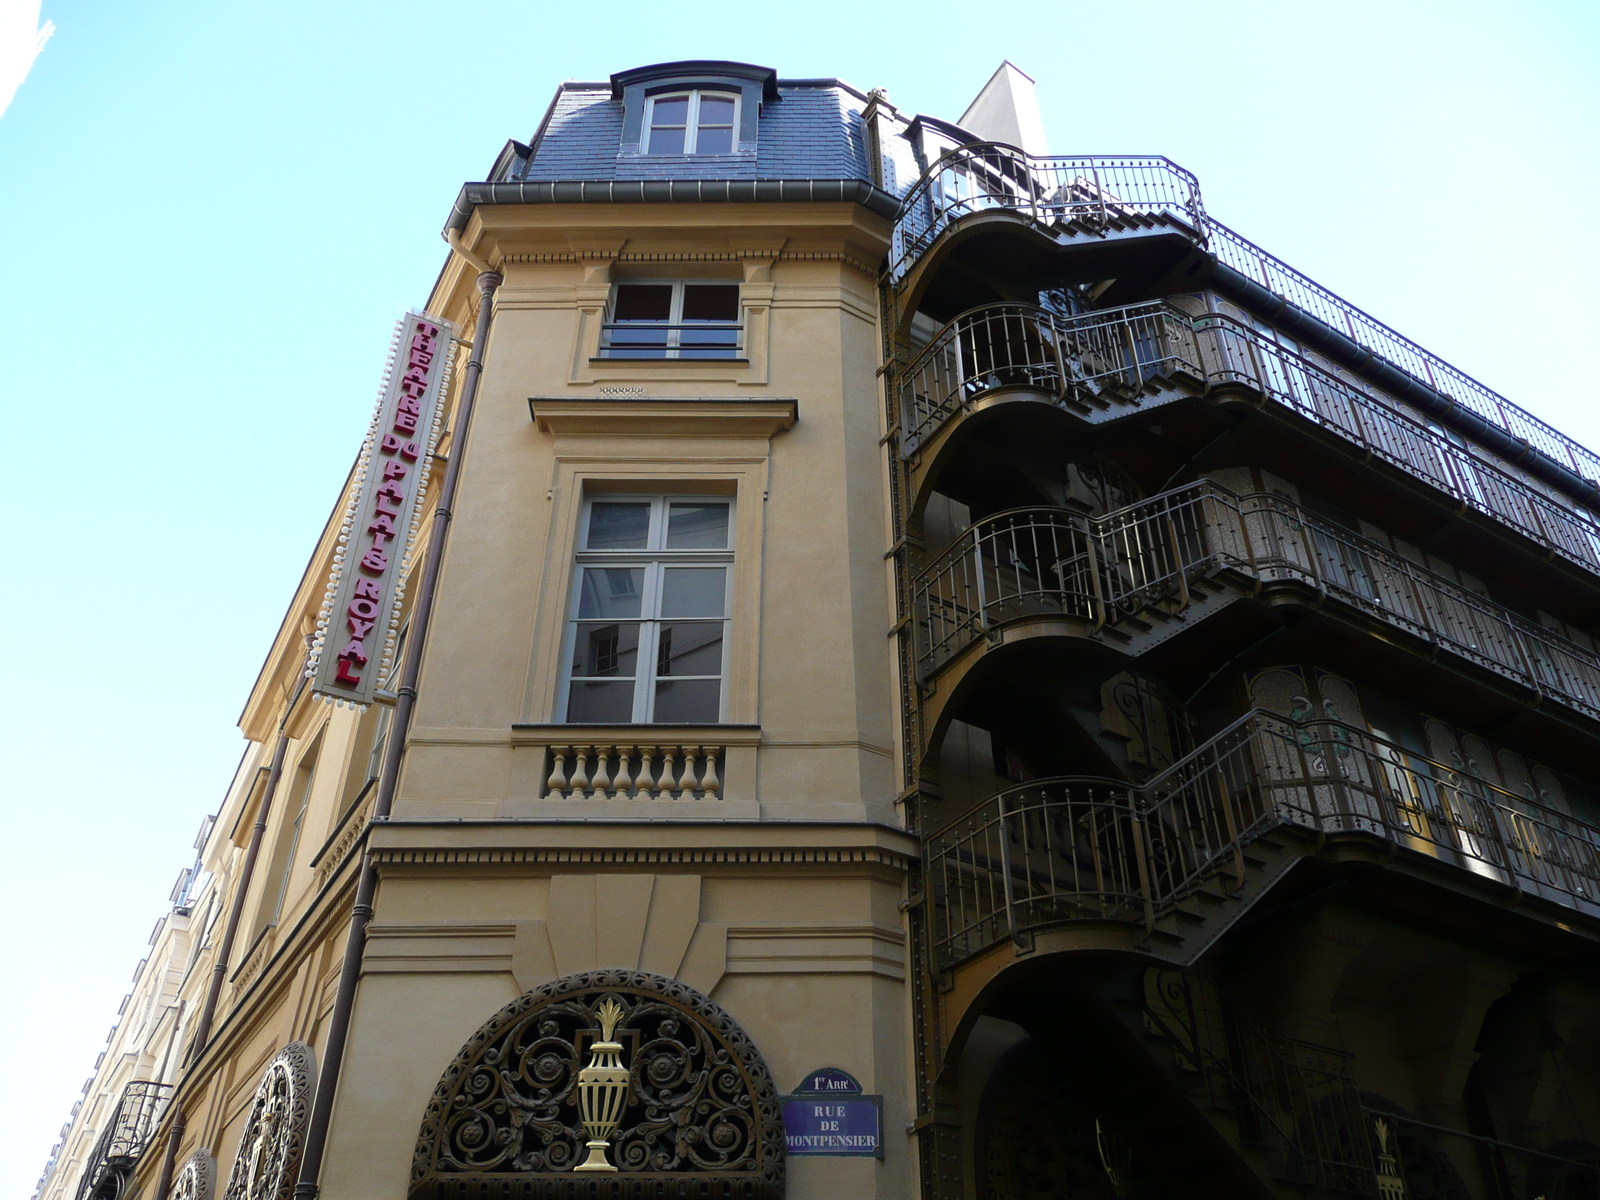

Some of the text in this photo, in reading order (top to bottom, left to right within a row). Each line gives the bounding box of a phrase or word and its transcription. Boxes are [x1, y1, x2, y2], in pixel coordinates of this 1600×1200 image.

[335, 321, 438, 687] THEATRE DU PALAIS ROYAL
[814, 1106, 846, 1117] RUE
[820, 1121, 839, 1131] DE
[786, 1135, 876, 1147] MONTPENSIER
